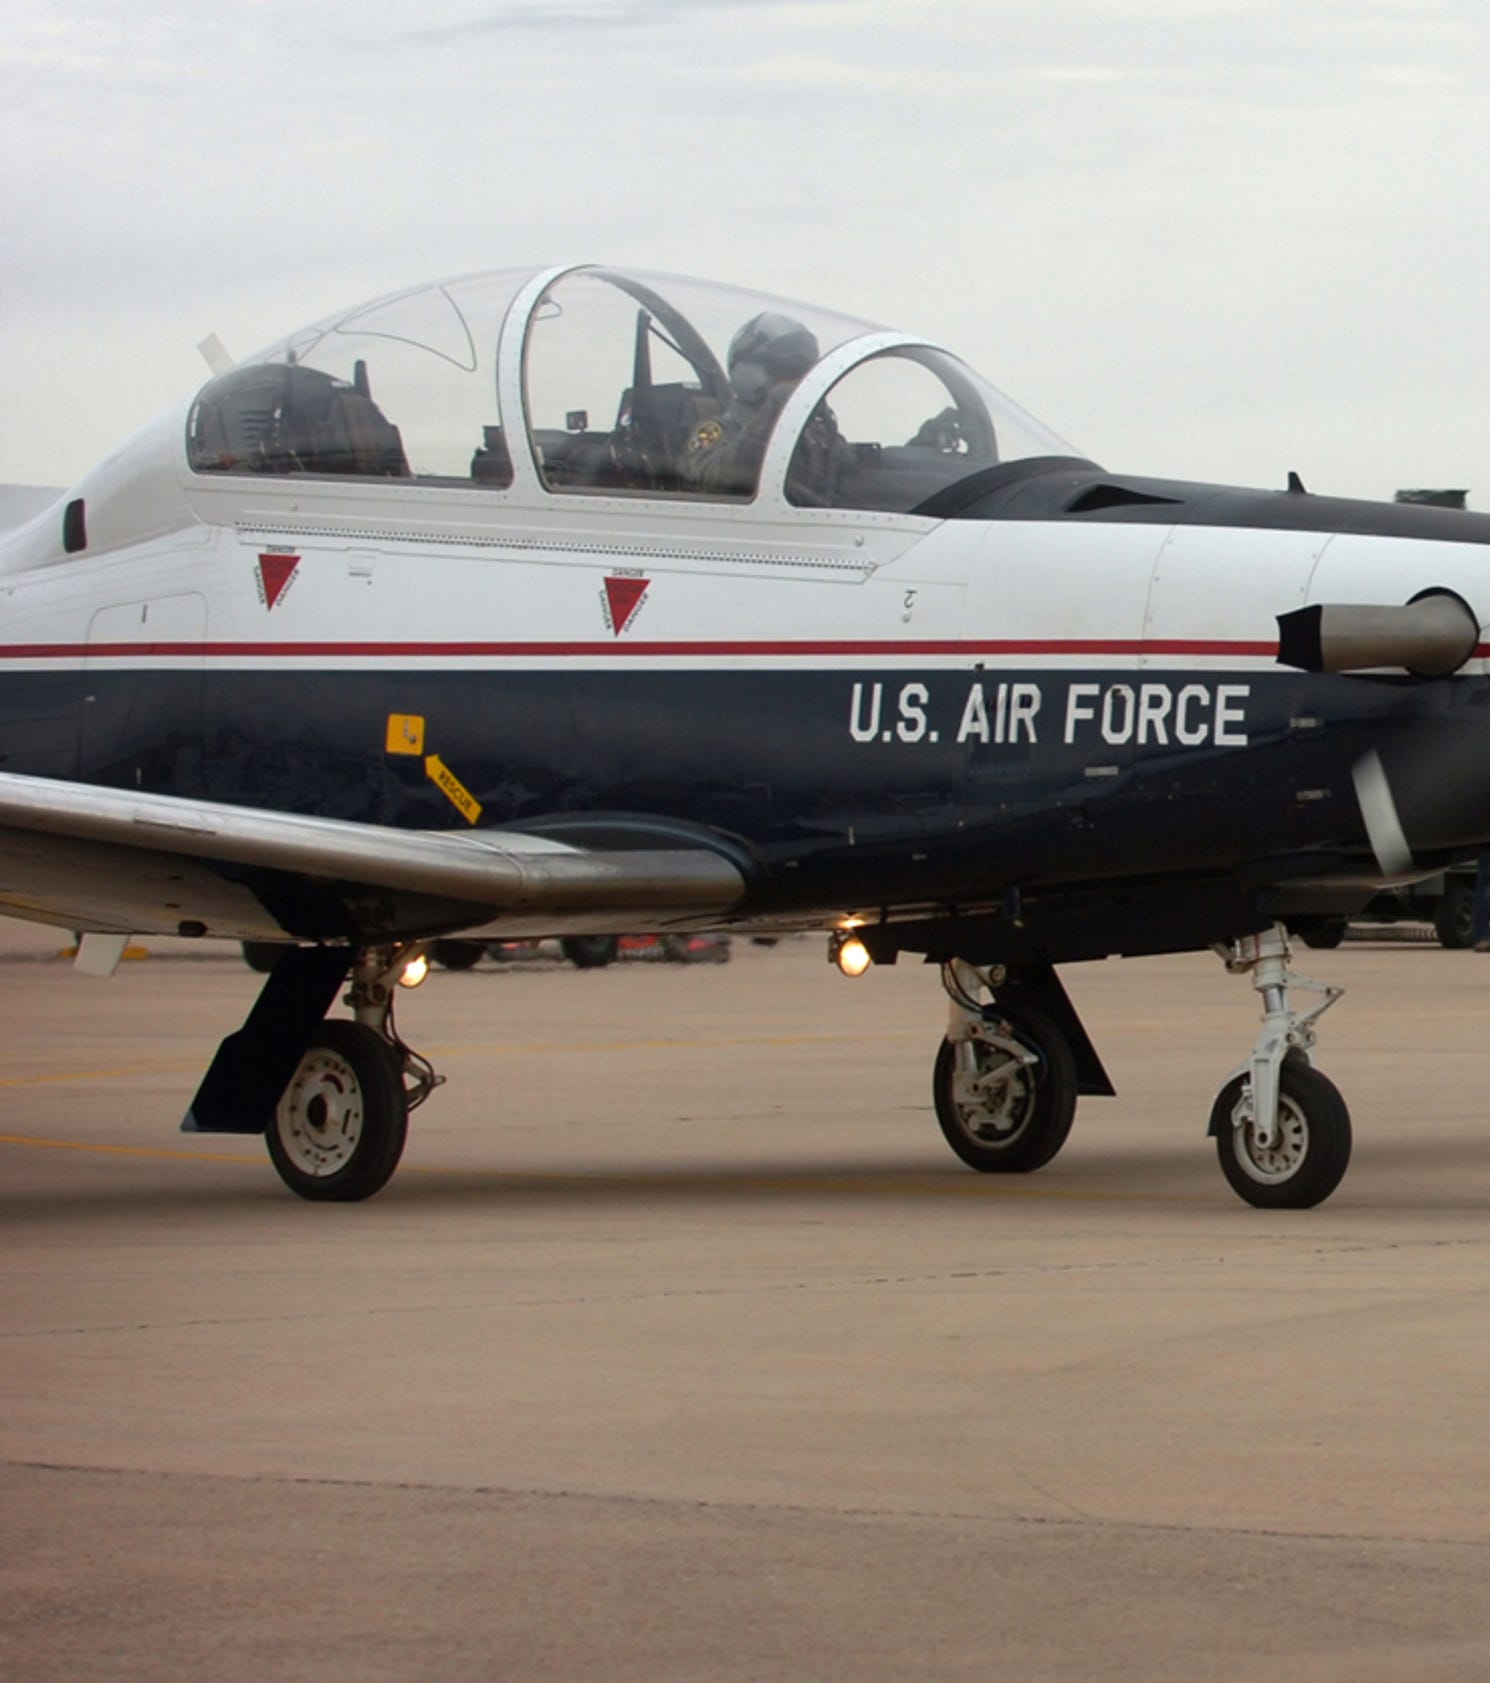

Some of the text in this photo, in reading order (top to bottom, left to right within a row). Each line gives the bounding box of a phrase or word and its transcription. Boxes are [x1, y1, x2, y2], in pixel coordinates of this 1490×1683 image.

[848, 682, 1251, 747] U.S. AIR FORCE
[438, 770, 474, 812] RESCUE
